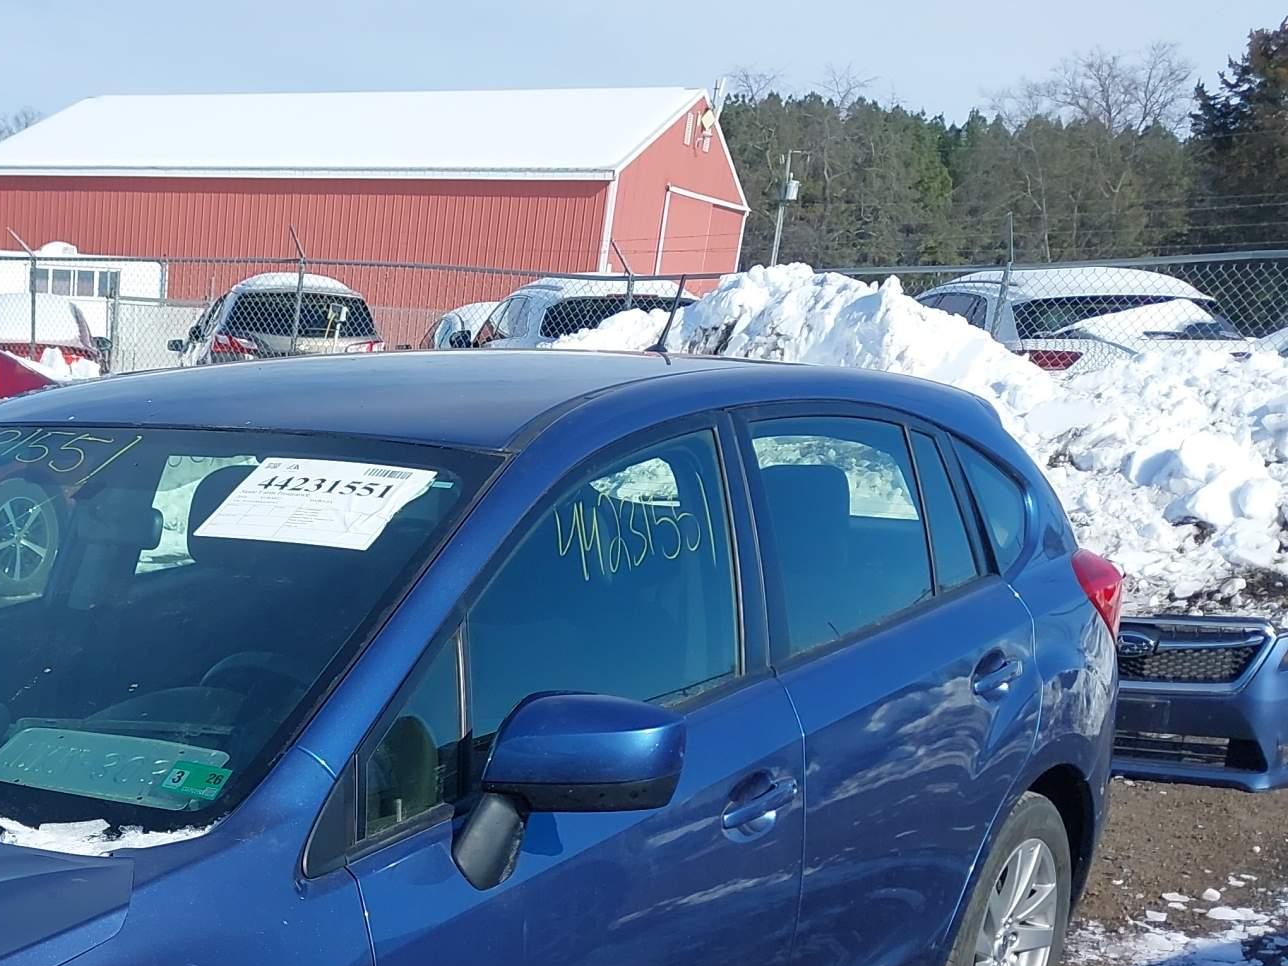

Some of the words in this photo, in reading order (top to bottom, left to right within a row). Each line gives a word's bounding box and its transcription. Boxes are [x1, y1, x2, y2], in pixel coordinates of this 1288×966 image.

[257, 474, 395, 500] 44231551
[171, 770, 185, 784] 3
[205, 773, 224, 785] 26
